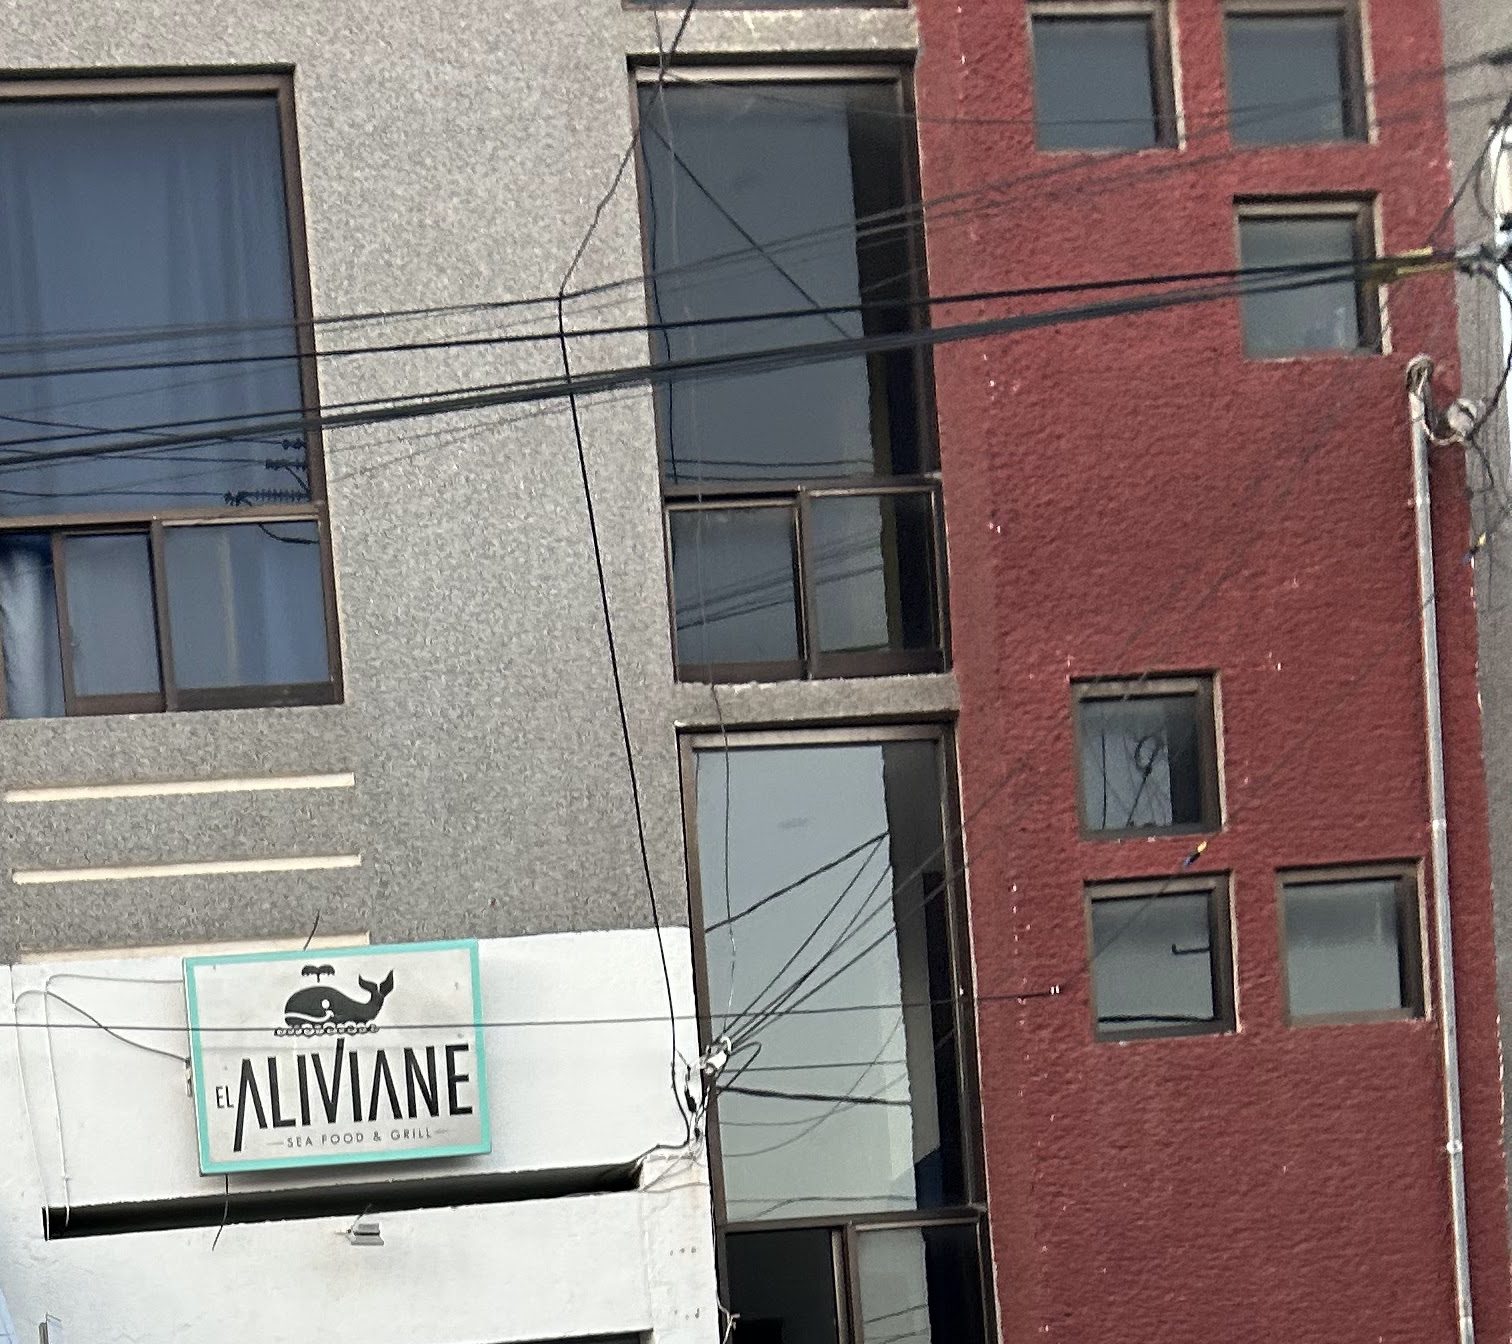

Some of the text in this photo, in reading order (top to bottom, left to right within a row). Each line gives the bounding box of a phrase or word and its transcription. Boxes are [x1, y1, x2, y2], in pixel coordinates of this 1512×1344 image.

[215, 1037, 473, 1152] EL ALIVIANE
[287, 1126, 432, 1148] SEA FOOD & GRILL
